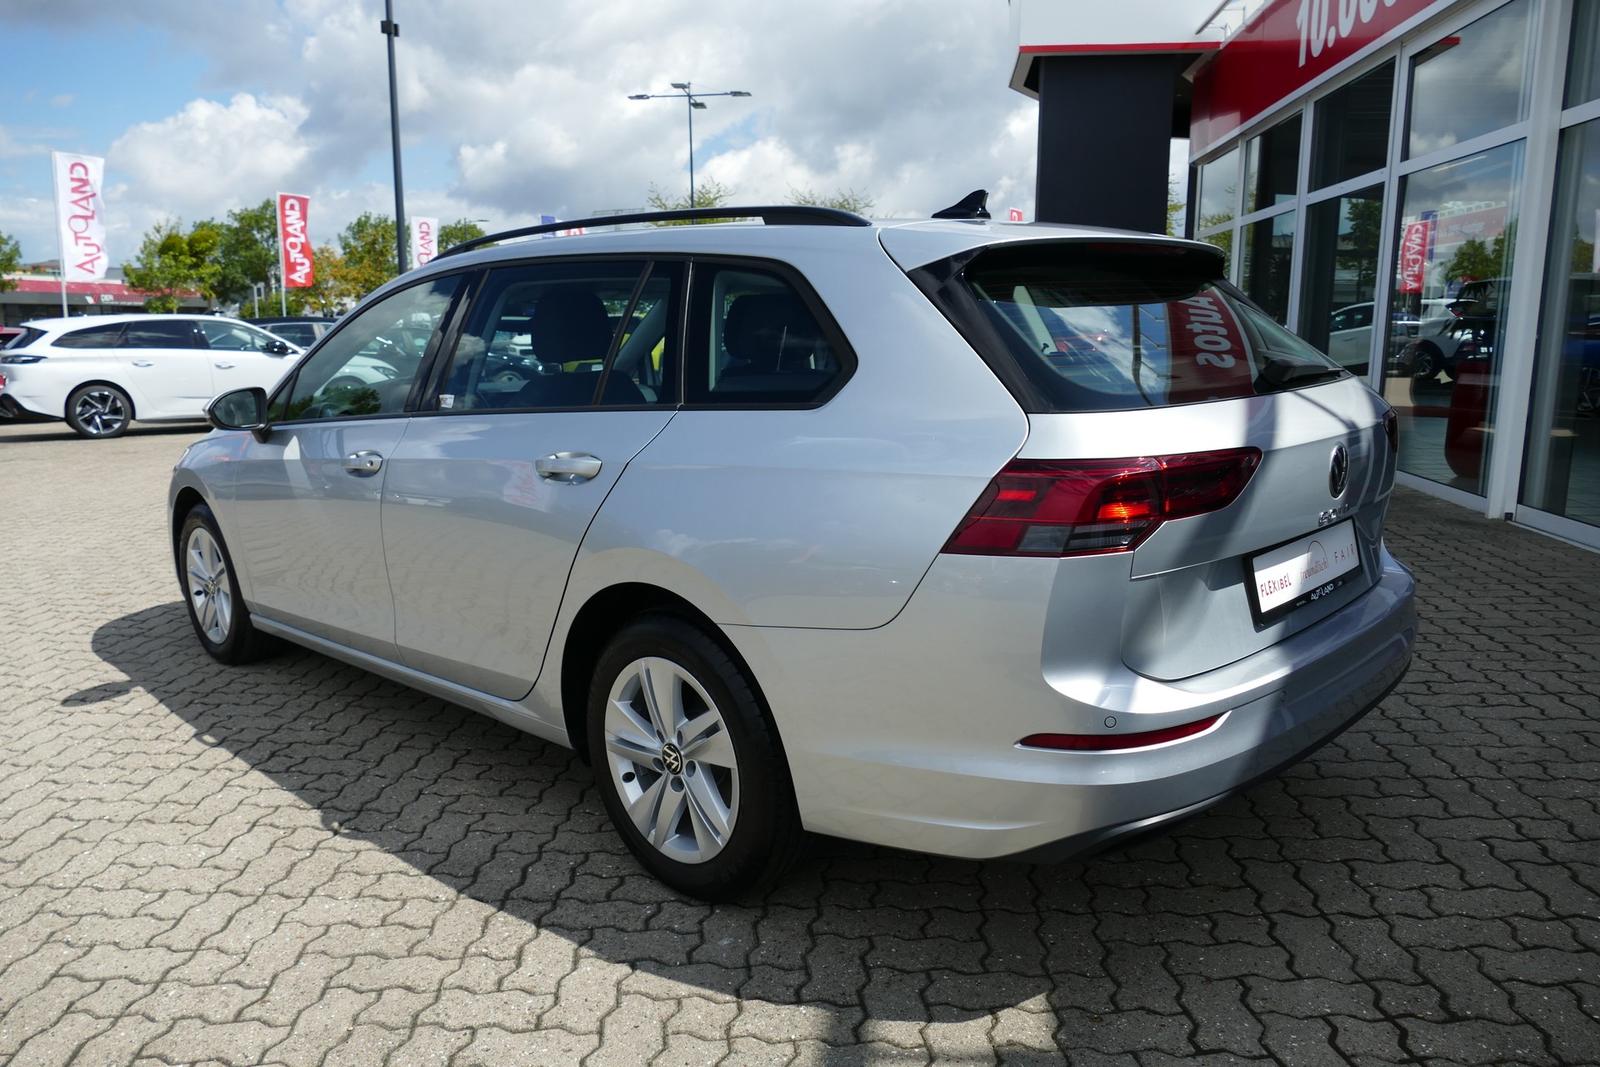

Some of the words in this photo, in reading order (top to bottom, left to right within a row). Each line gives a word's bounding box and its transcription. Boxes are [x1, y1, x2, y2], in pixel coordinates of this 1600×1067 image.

[68, 162, 101, 274] AUTOLAND
[284, 198, 310, 284] AUTOLAND
[416, 221, 434, 265] OLAND
